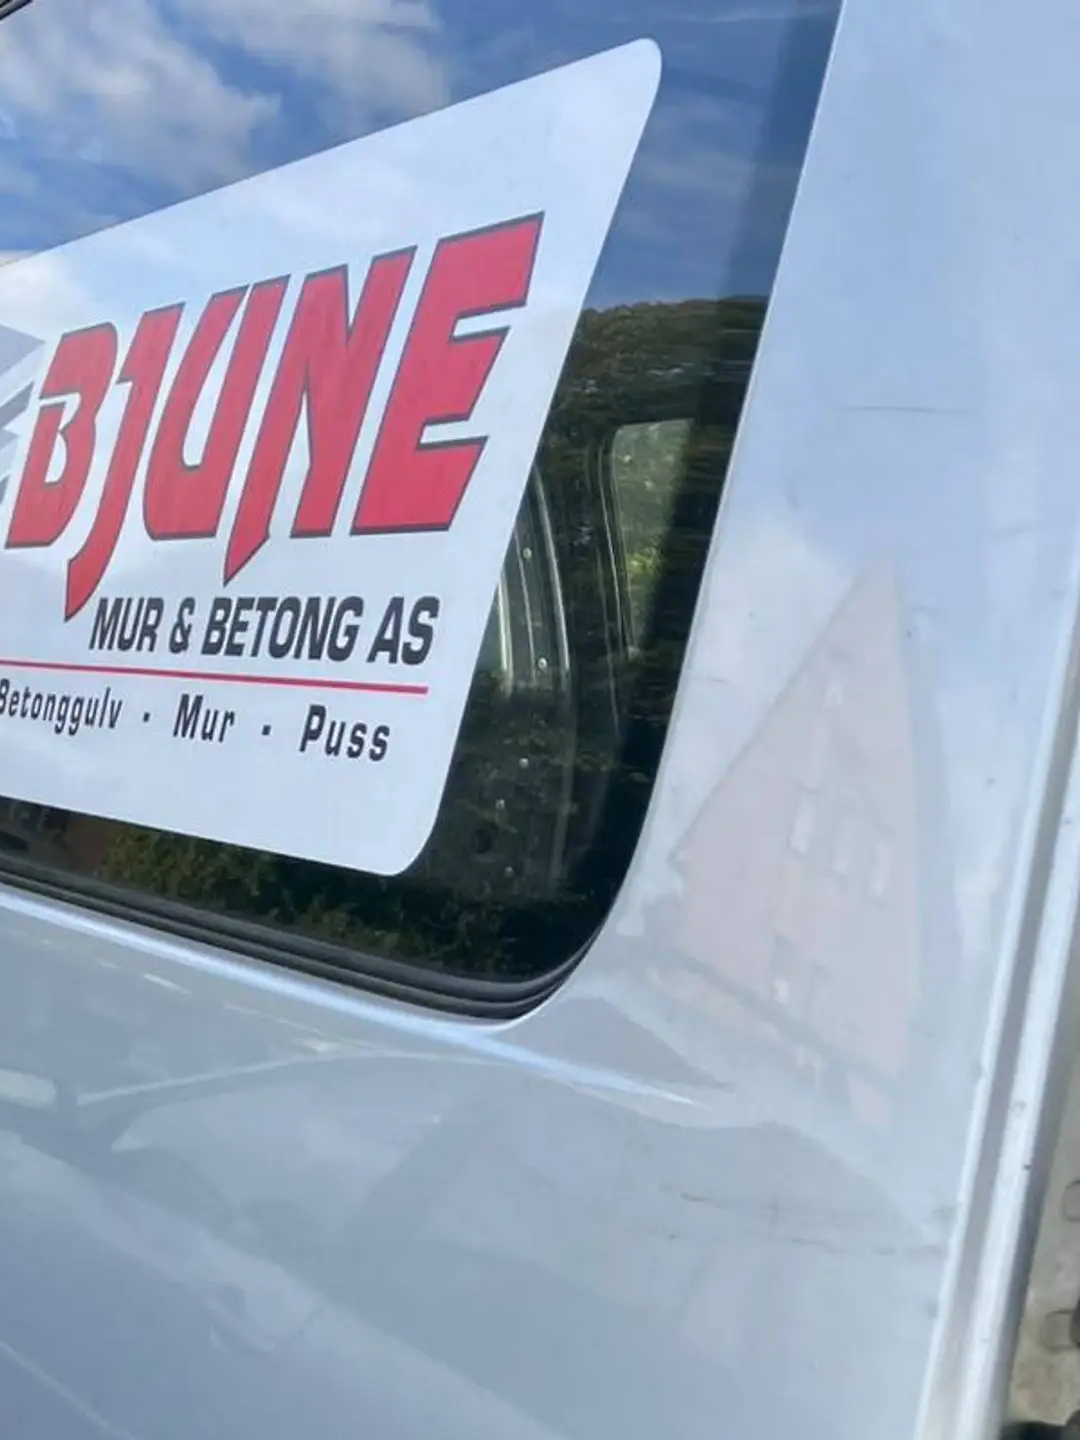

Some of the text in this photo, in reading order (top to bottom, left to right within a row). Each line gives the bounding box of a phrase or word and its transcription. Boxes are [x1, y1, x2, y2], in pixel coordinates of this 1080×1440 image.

[4, 211, 545, 621] BJUNE
[89, 595, 440, 665] MUR & BETONG AS
[173, 693, 236, 743] Mur
[299, 703, 391, 761] Puss
